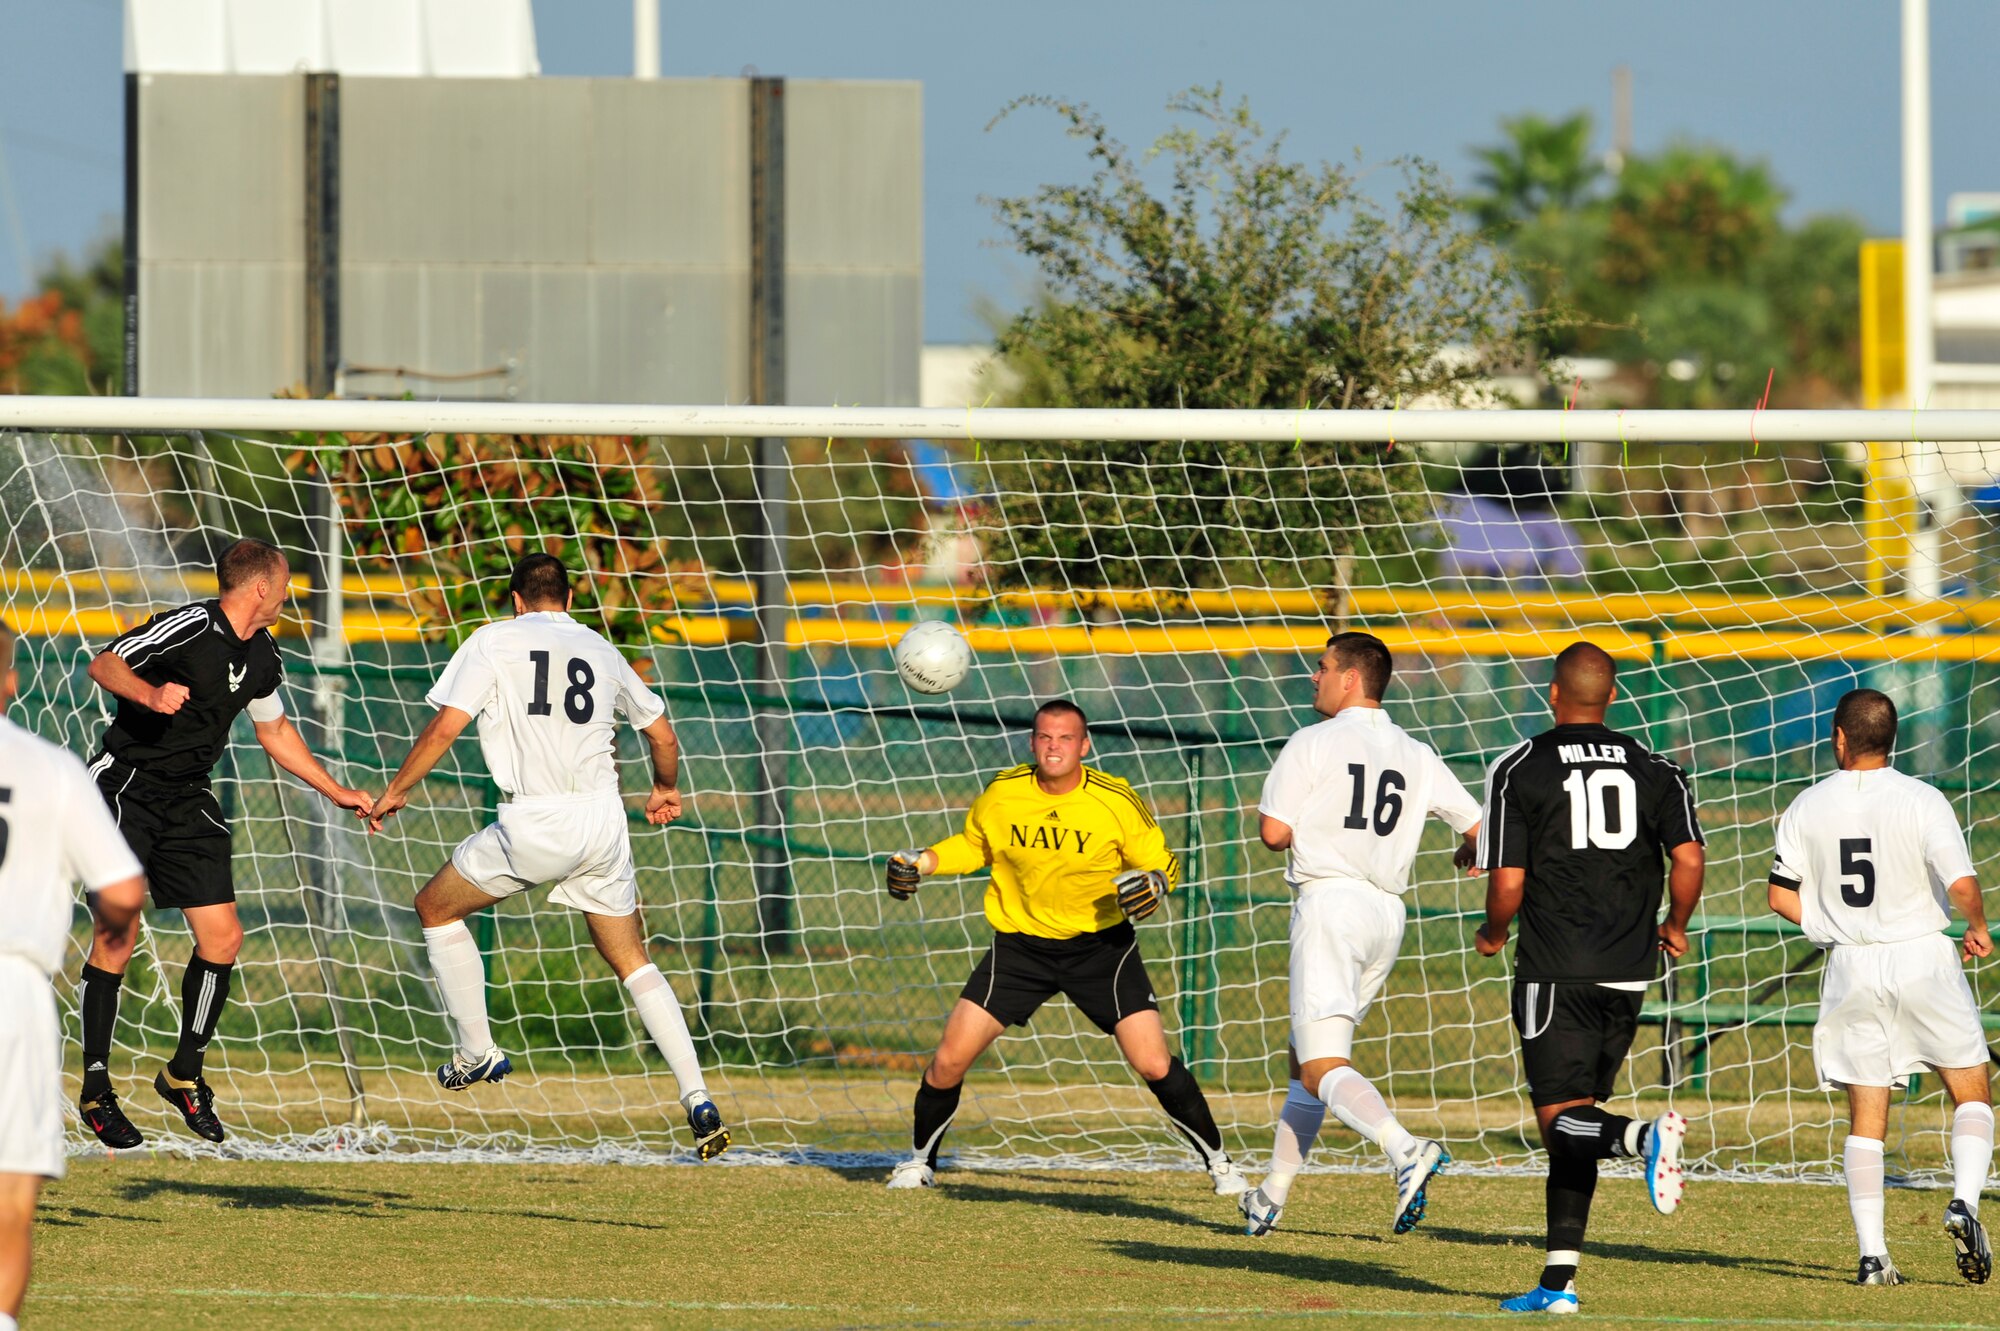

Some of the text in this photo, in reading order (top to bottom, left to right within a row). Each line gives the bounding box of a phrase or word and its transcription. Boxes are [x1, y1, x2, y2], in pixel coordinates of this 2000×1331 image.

[528, 650, 595, 724] 18
[902, 661, 937, 687] molten
[1557, 743, 1628, 764] MILLER
[1343, 763, 1406, 837] 16
[1562, 768, 1638, 850] 10
[1009, 823, 1092, 854] NAVY
[1839, 837, 1876, 908] 5
